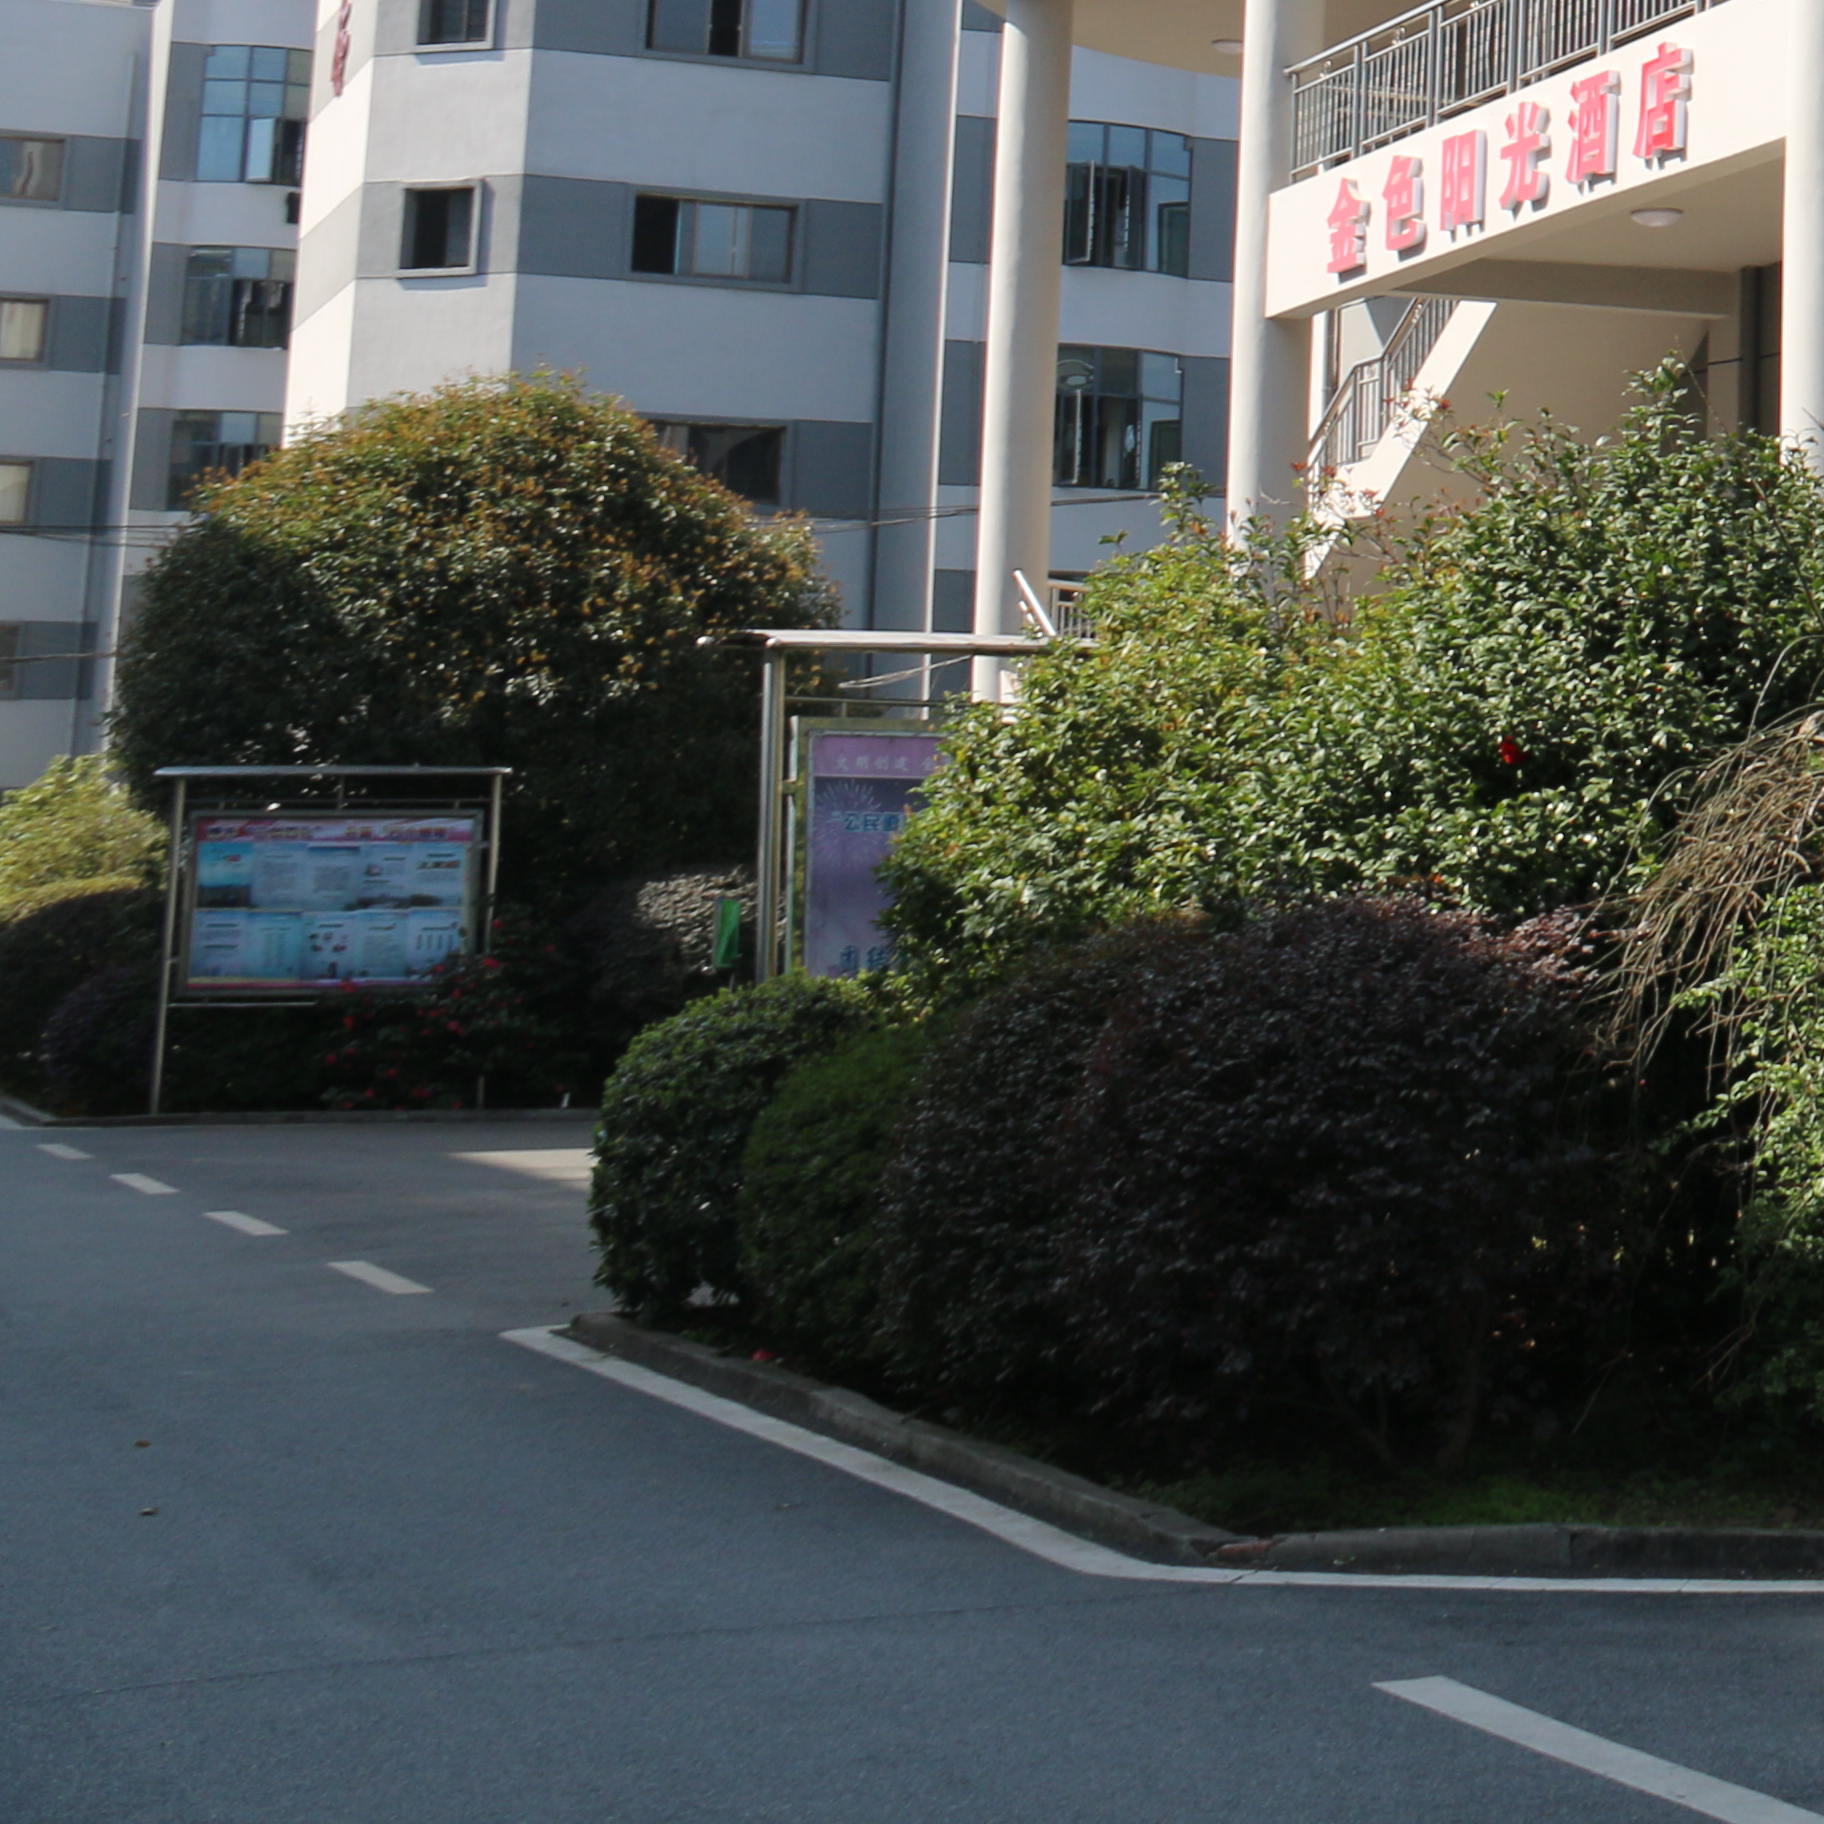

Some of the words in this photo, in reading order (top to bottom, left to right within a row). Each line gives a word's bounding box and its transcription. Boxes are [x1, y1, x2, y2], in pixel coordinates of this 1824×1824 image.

[1326, 41, 1693, 275] 金色阳光酒店
